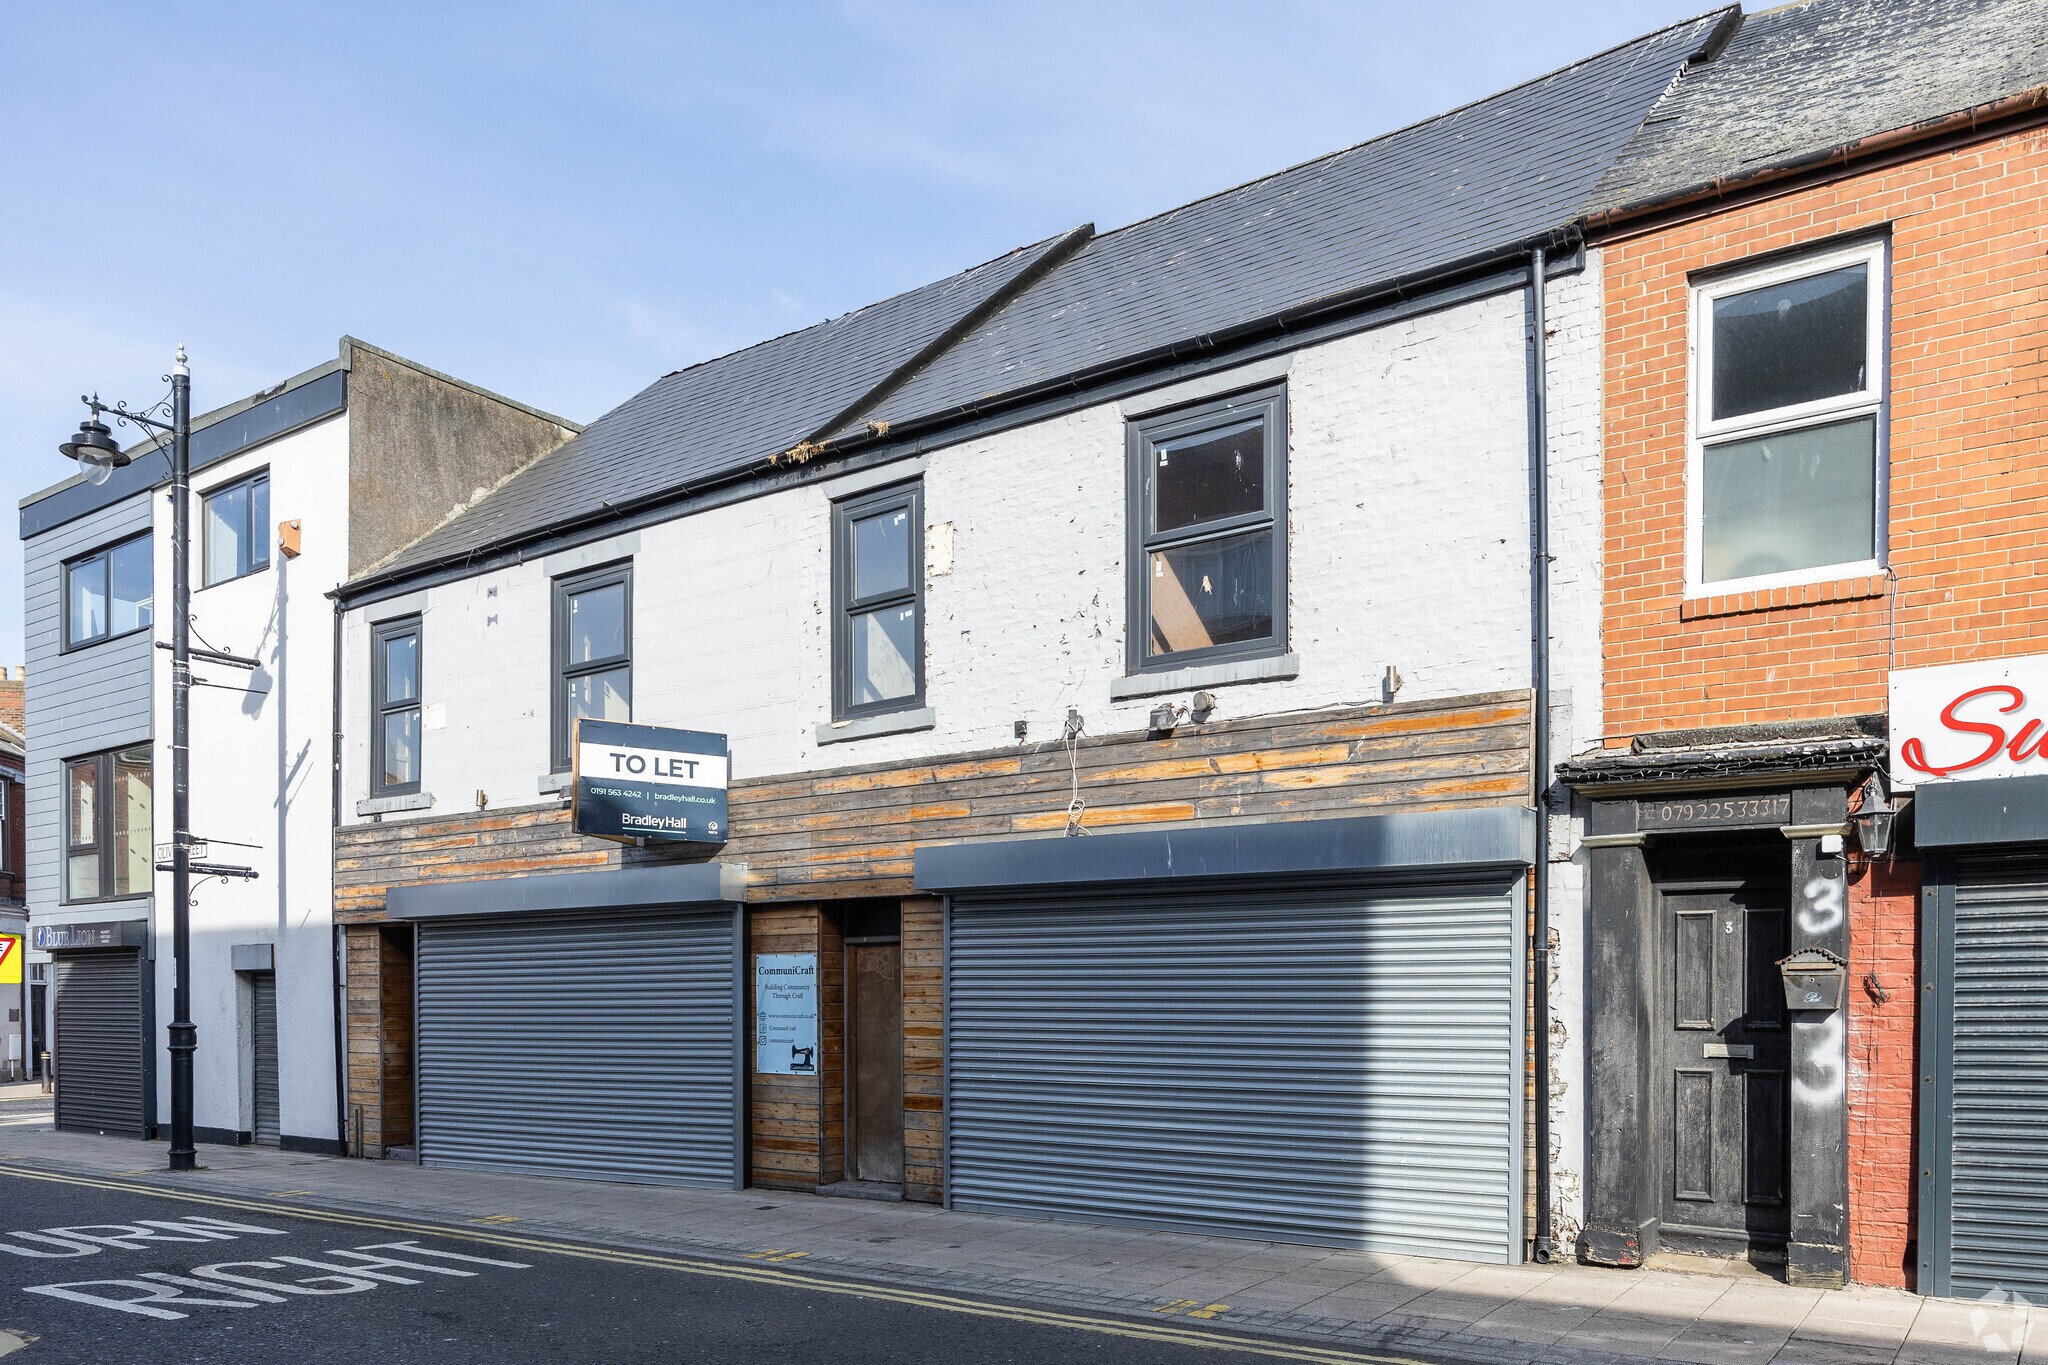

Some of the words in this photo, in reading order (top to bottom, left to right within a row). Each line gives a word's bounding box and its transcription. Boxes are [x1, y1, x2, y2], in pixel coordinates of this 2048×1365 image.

[610, 752, 646, 774] TO
[655, 757, 699, 779] LET
[590, 787, 606, 795] 0191
[608, 788, 622, 796] 563
[623, 789, 642, 798] 4242
[654, 792, 716, 804] bradleyhall.co.uk
[1661, 799, 1790, 821] 07922533317
[1799, 877, 1844, 934] 3
[45, 926, 69, 947] BLUE
[70, 925, 95, 946] LION
[1725, 921, 1733, 934] 3
[758, 965, 814, 976] CommuniCraft
[772, 992, 791, 1001] Through
[783, 983, 810, 991] Community
[22, 1241, 534, 1320] RIGHT
